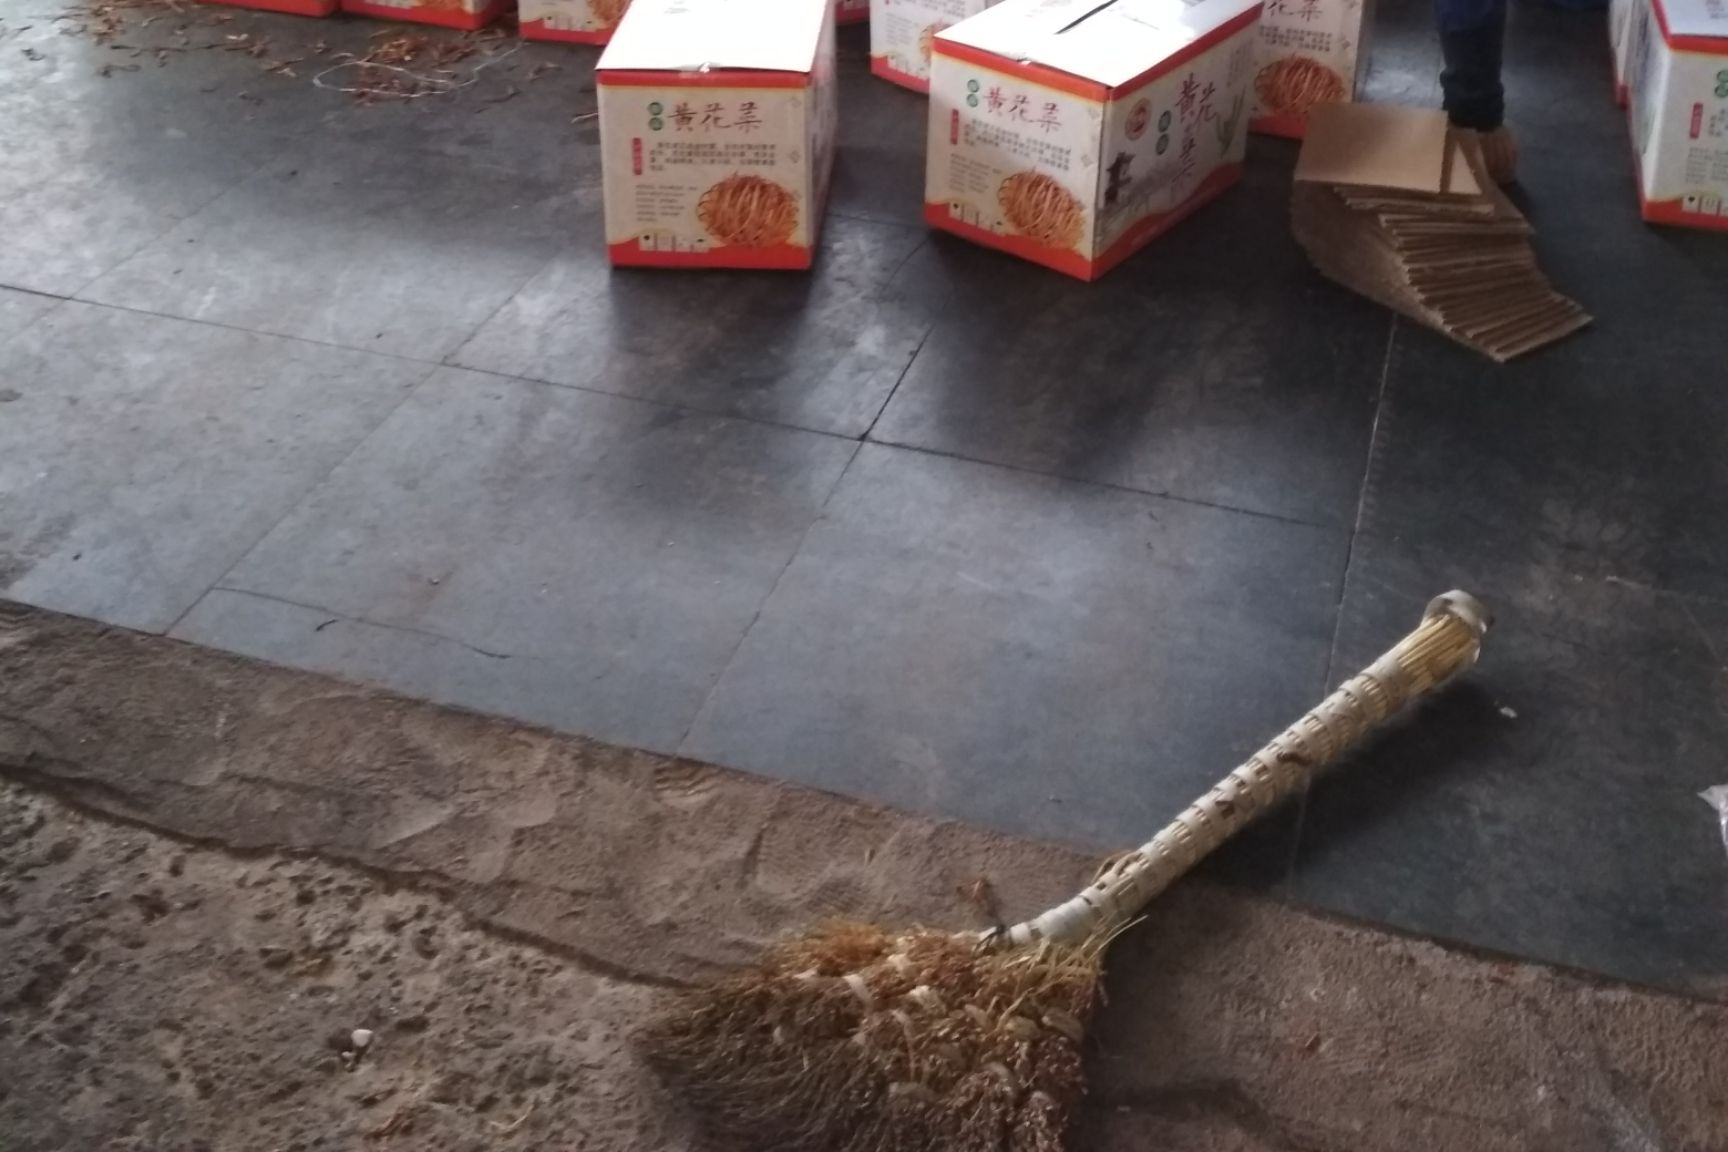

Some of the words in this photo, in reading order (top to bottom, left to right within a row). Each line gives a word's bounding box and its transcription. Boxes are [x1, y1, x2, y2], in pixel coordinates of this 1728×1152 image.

[667, 101, 763, 134] 黄花菜
[983, 85, 1063, 134] 黄花菜
